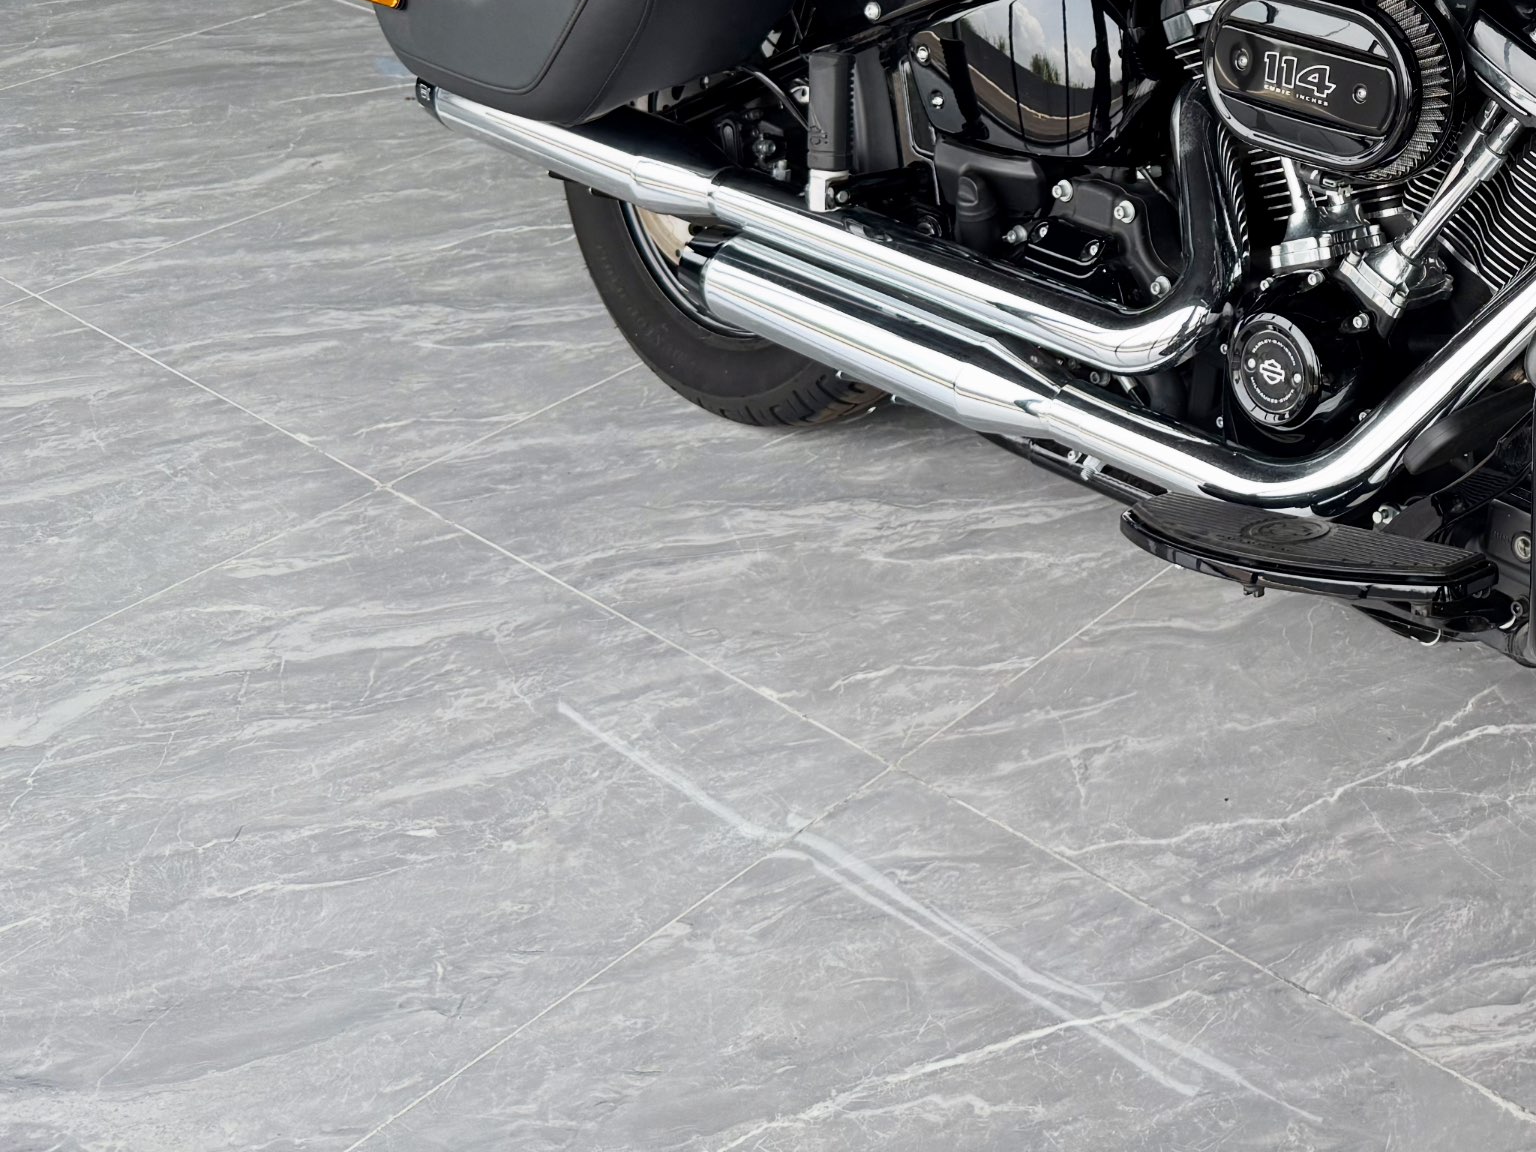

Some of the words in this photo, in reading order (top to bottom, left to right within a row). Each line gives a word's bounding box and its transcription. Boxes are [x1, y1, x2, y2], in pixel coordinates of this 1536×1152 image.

[1264, 51, 1337, 98] 114
[1263, 84, 1291, 96] CUBIC
[1296, 93, 1329, 107] INCHES
